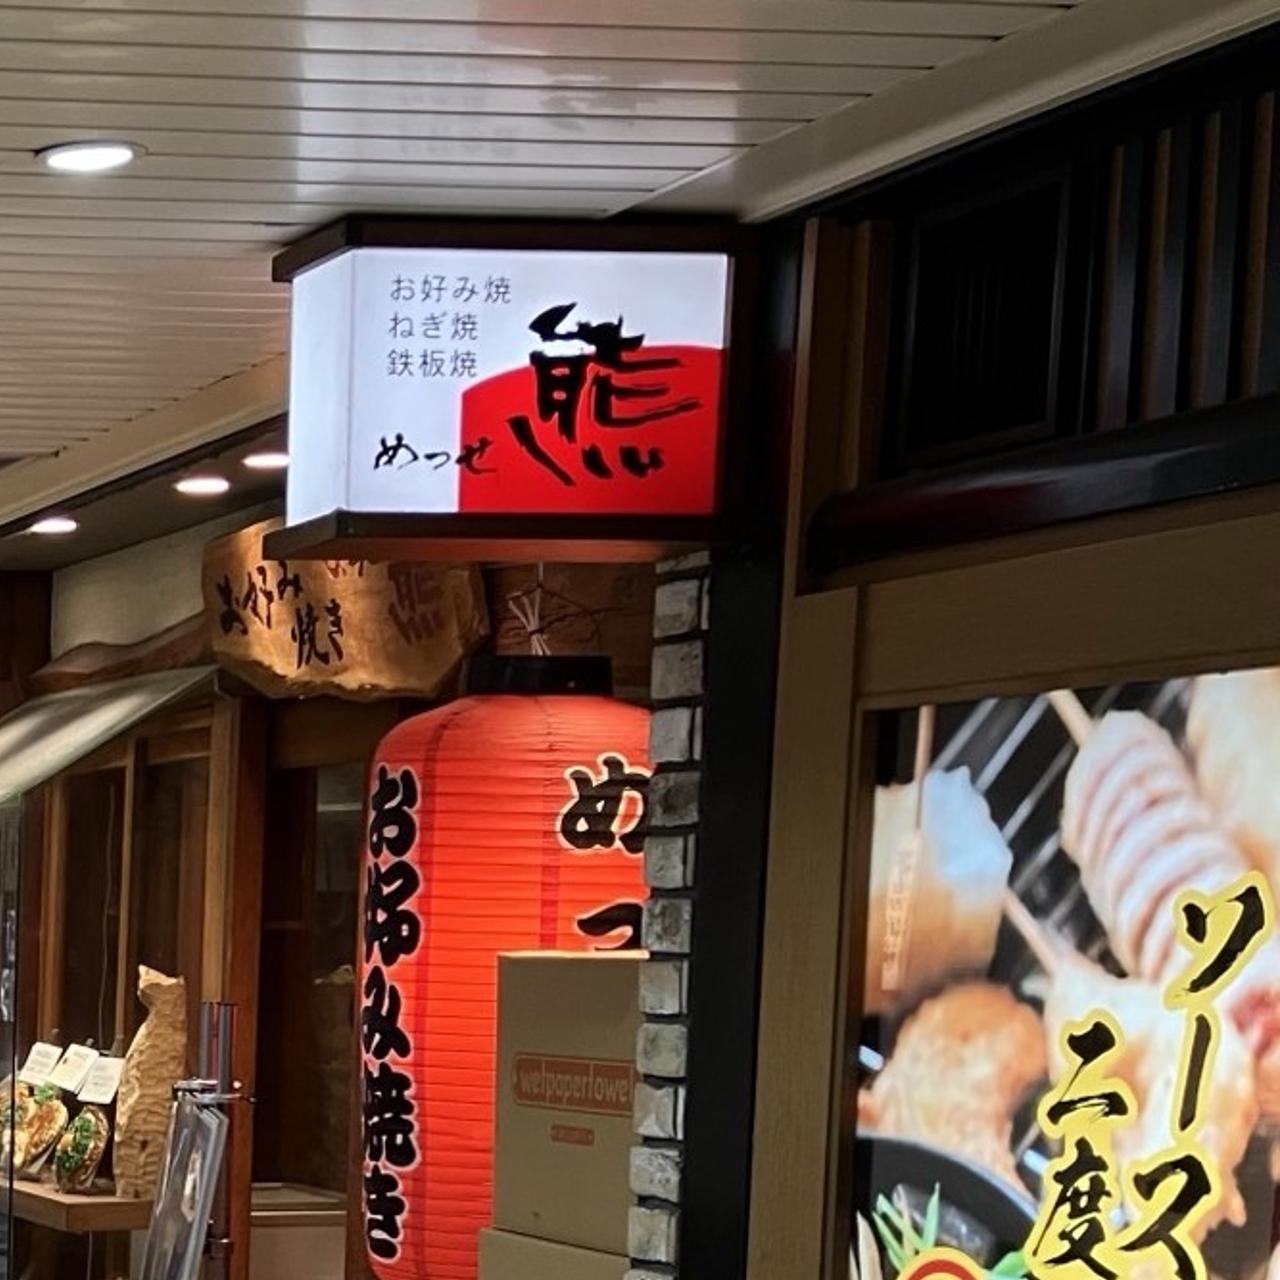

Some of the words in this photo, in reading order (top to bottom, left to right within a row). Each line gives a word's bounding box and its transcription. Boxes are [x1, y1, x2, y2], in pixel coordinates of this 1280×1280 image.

[390, 275, 511, 304] お好み焼
[388, 312, 479, 341] ねぎ焼
[387, 349, 478, 378] 鉄板焼
[373, 433, 499, 474] めっせ
[362, 766, 420, 1260] お好み焼き
